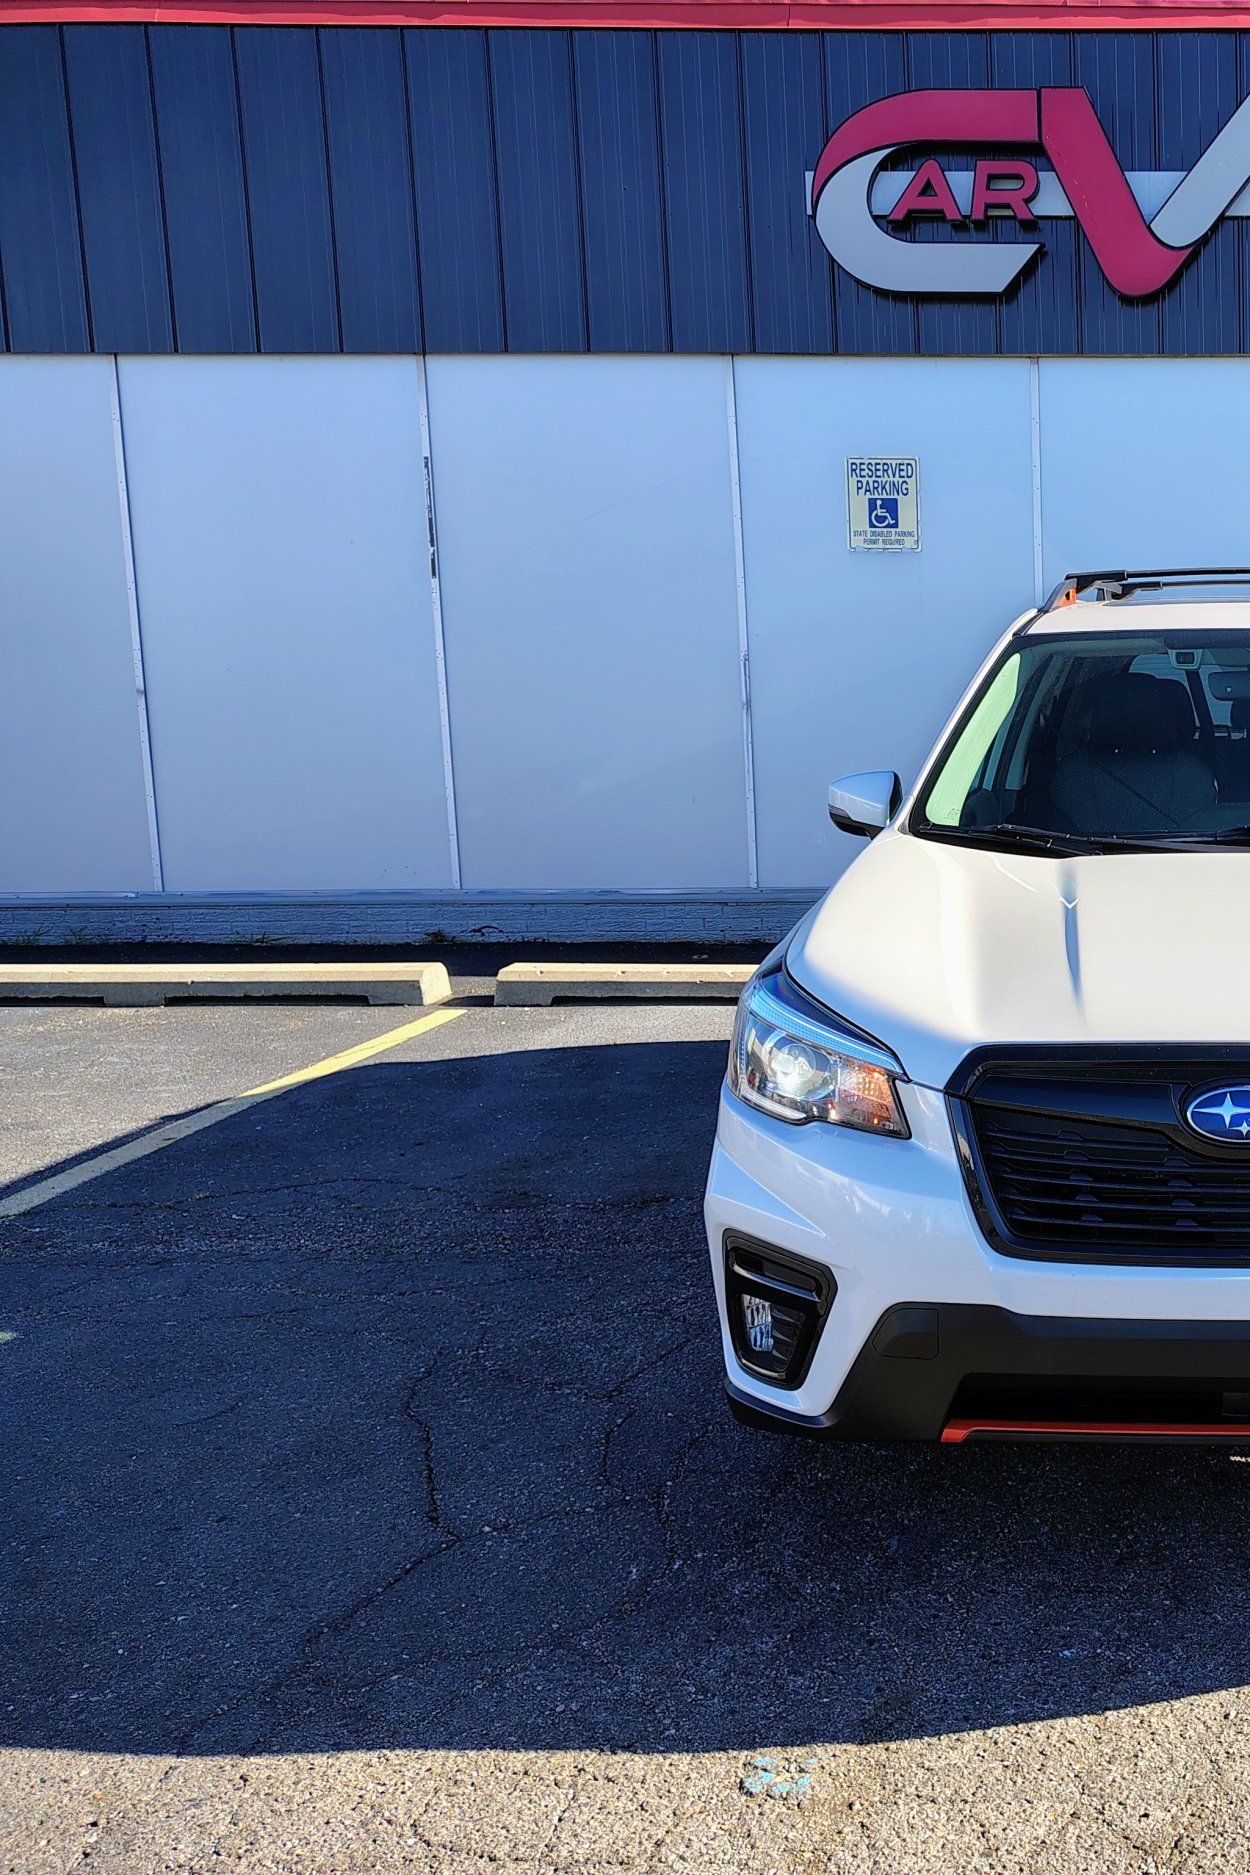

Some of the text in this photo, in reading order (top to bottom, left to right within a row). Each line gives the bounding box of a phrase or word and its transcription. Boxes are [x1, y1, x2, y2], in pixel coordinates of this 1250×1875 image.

[850, 462, 914, 479] RESERVED
[856, 480, 909, 496] PARKING
[853, 530, 915, 538] STATE DISABLED PARKING
[882, 538, 906, 546] REQUIRED
